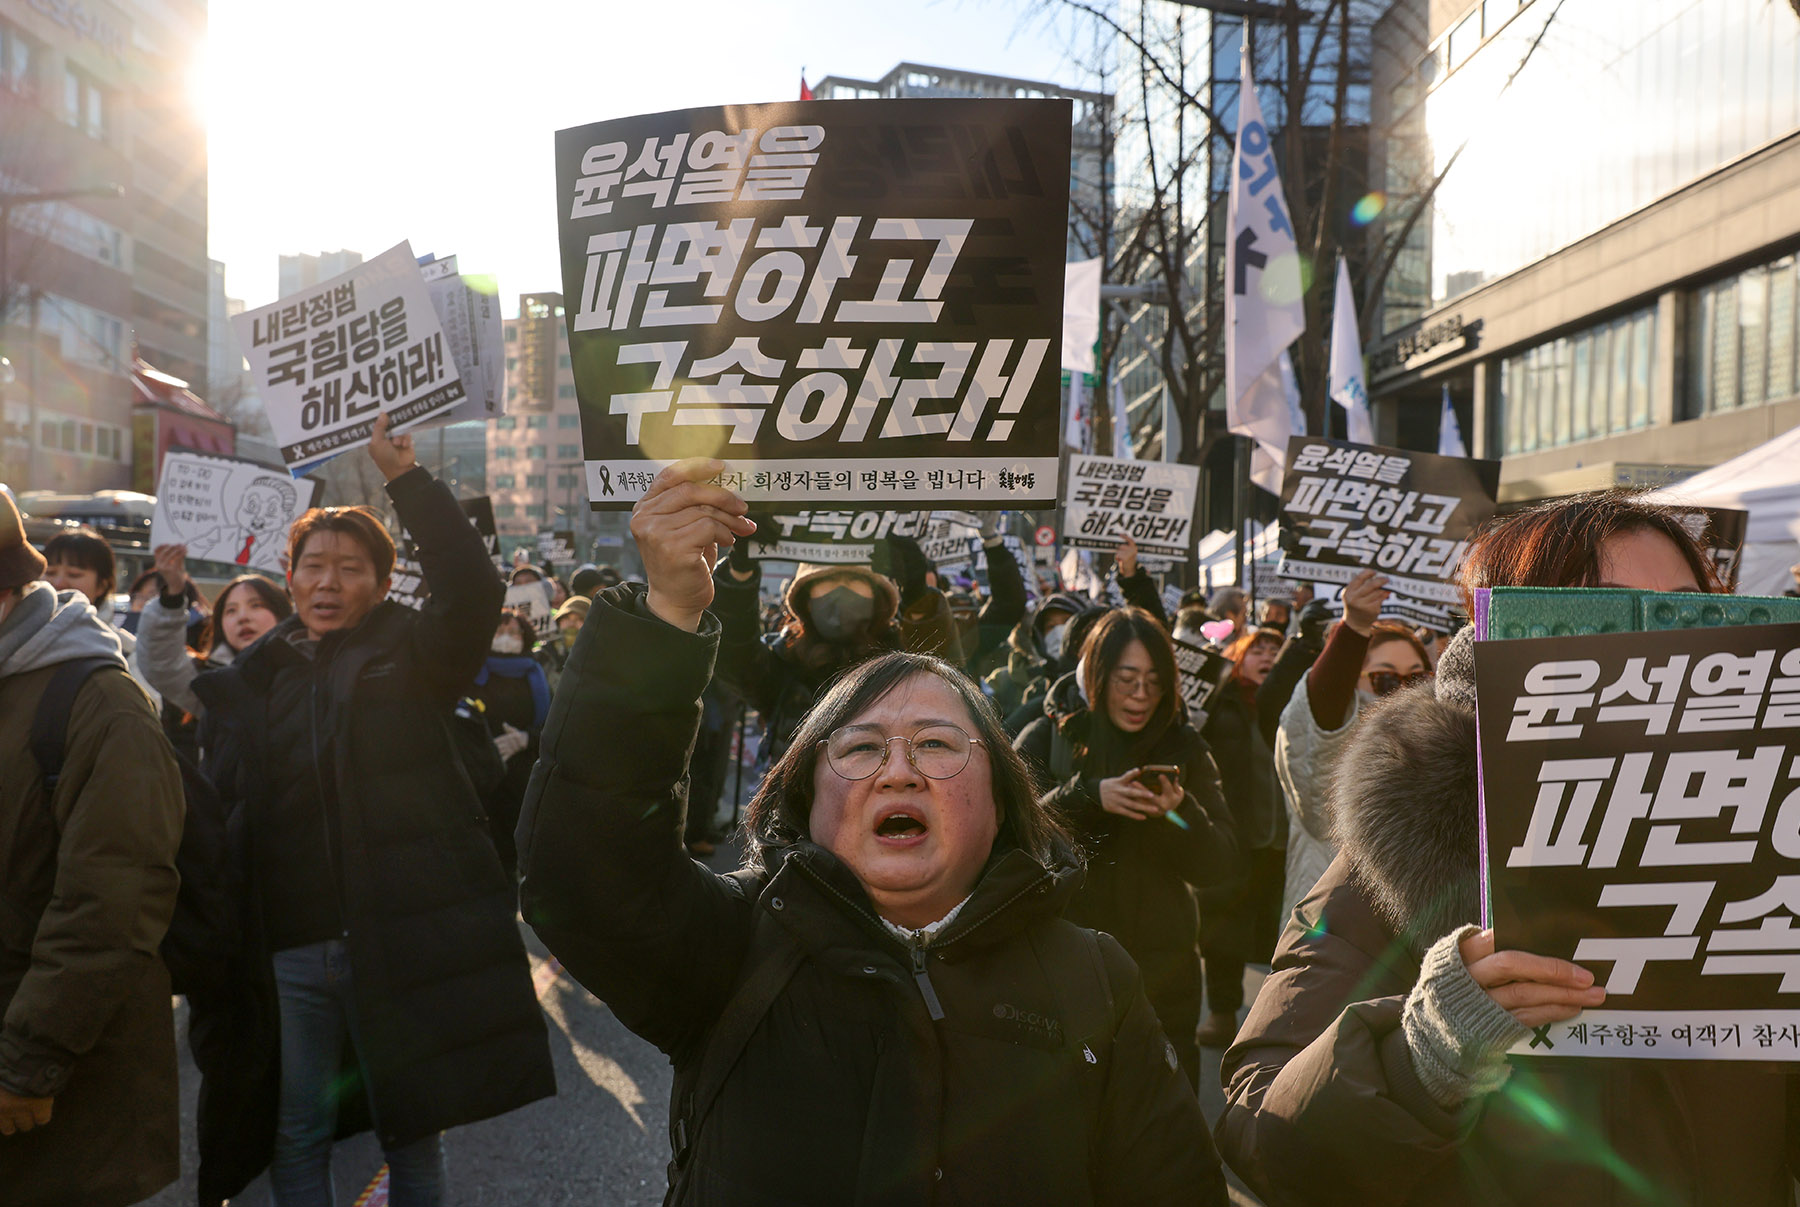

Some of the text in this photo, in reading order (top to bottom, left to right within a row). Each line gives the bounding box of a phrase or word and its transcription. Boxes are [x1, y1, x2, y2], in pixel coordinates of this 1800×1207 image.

[570, 125, 825, 220] 윤석열을
[573, 215, 975, 332] 파면하고
[253, 280, 357, 348] 내란정범
[267, 296, 408, 387] 국힘당을
[301, 332, 444, 431] 해산하라!
[609, 336, 1051, 446] 구속하라!
[754, 470, 852, 492] 희생자들의
[861, 469, 920, 492] 명복을
[927, 469, 986, 492] 빕니다
[1075, 461, 1147, 483] 내란정범
[1292, 444, 1412, 485] 윤석열을
[1074, 481, 1173, 513] 국힘당을
[1080, 511, 1188, 543] 해산하라!
[1283, 476, 1461, 534] 파면하고
[1505, 744, 1800, 870] 파면
[1567, 1023, 1800, 1049] 제주항공 여객기 참사
